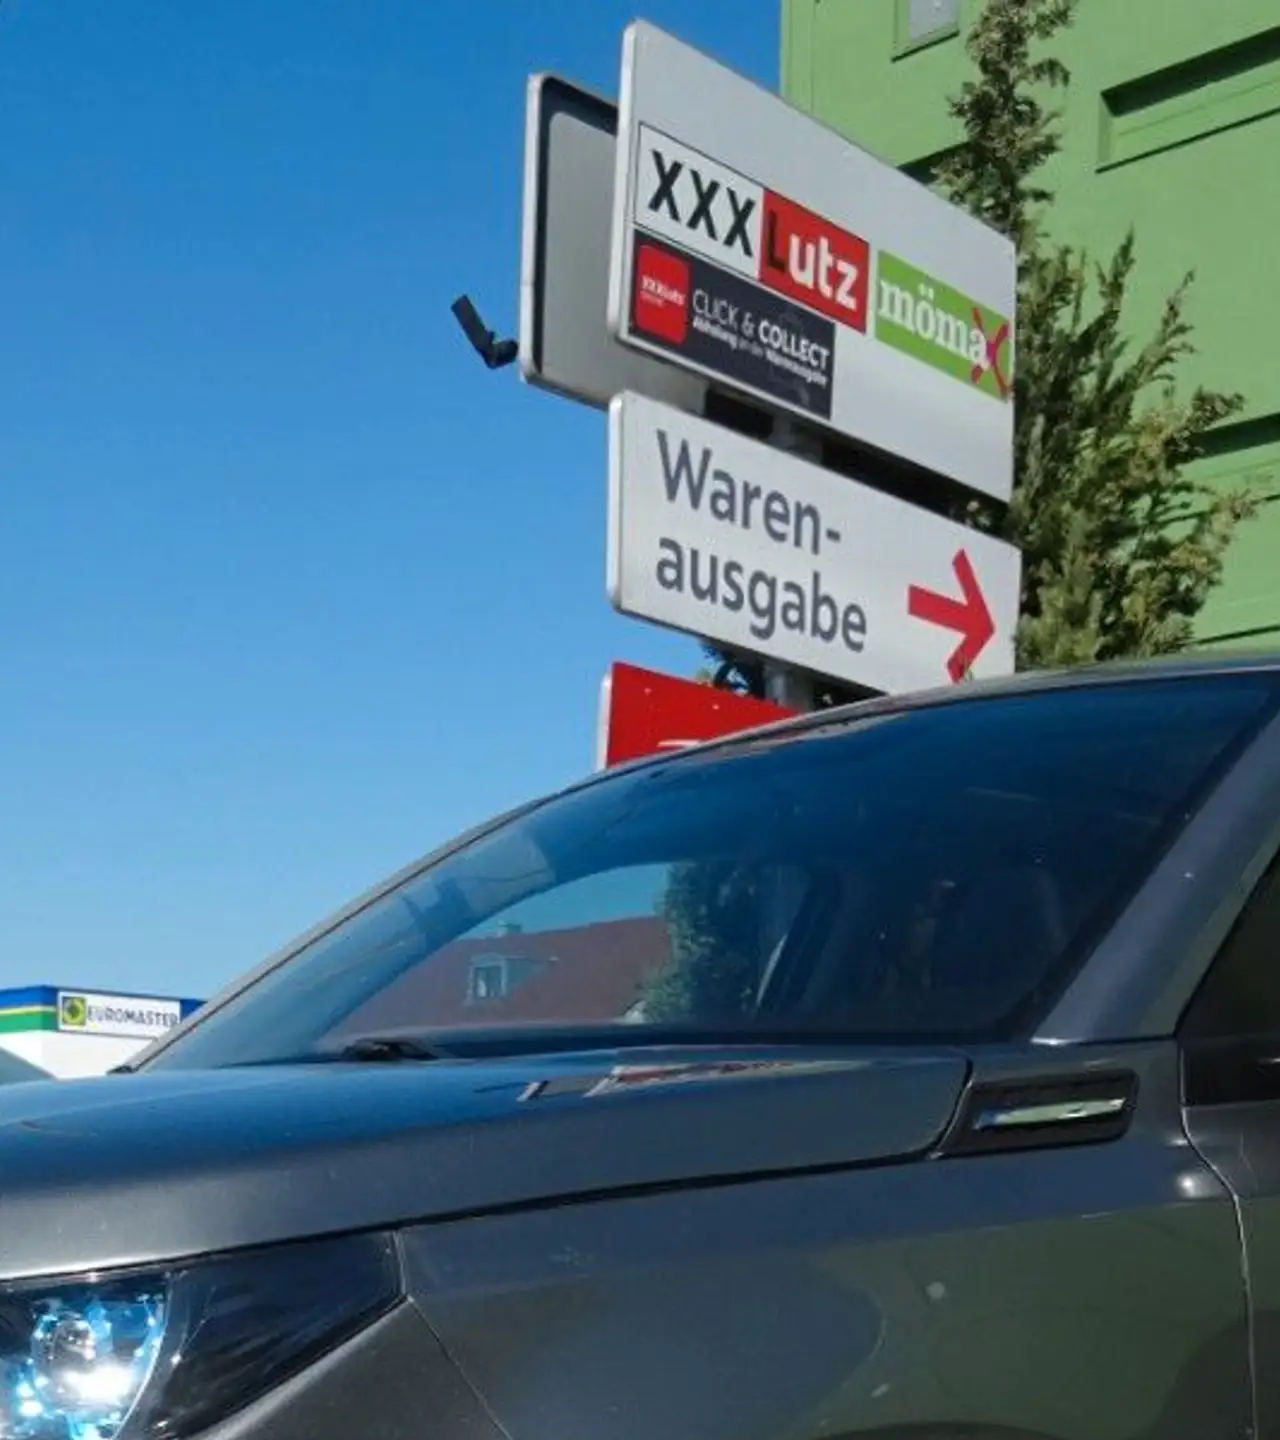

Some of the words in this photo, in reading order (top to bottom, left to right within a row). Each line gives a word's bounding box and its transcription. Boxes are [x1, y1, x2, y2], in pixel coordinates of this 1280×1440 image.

[692, 288, 739, 330] CLICK
[741, 311, 755, 337] &
[758, 319, 831, 371] COLLECT
[656, 428, 841, 556] Waren-
[656, 537, 867, 653] ausgabe
[87, 1004, 180, 1028] EUROMASTER
